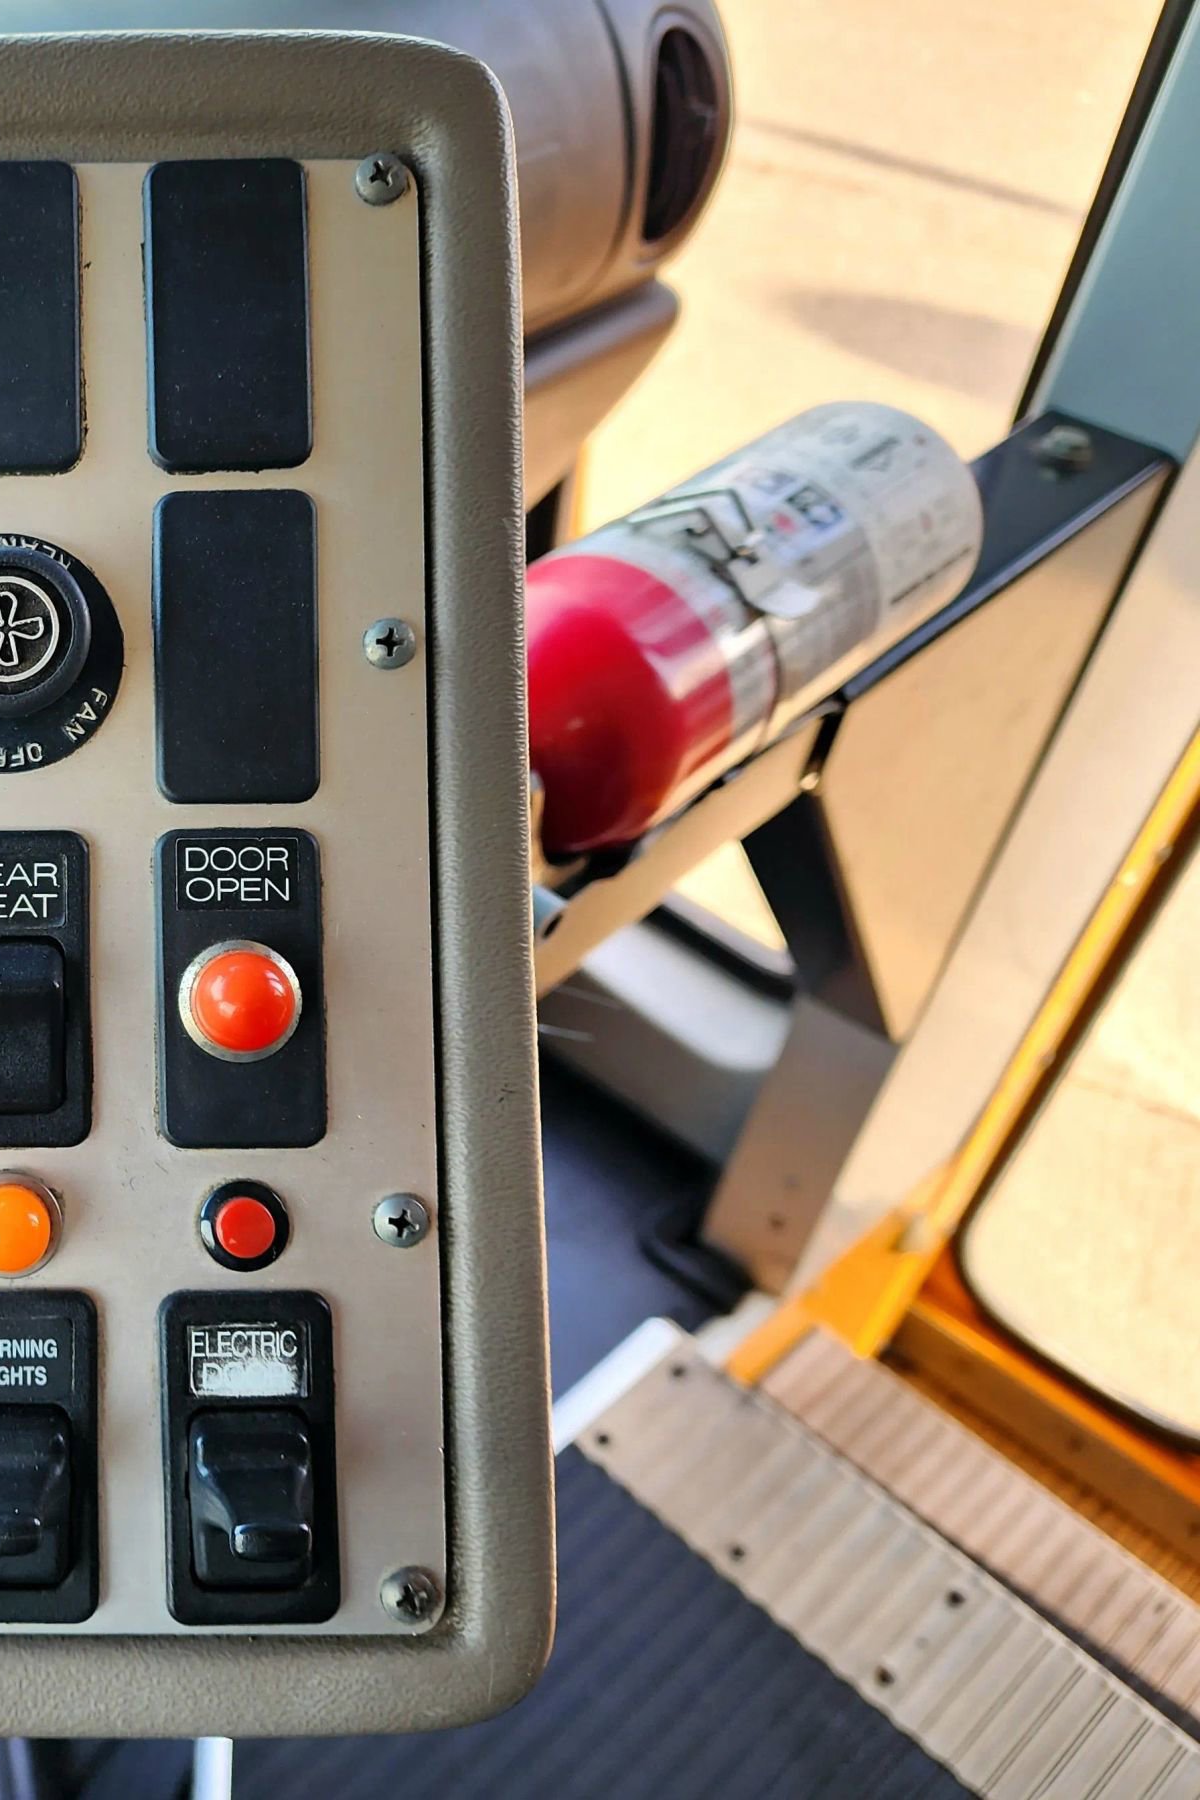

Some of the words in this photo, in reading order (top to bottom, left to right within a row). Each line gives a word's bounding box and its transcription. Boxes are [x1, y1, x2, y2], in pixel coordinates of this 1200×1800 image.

[63, 687, 109, 743] FAN
[185, 846, 289, 872] DOOR
[185, 877, 290, 902] OPEN
[191, 1330, 298, 1358] ELECTRIC
